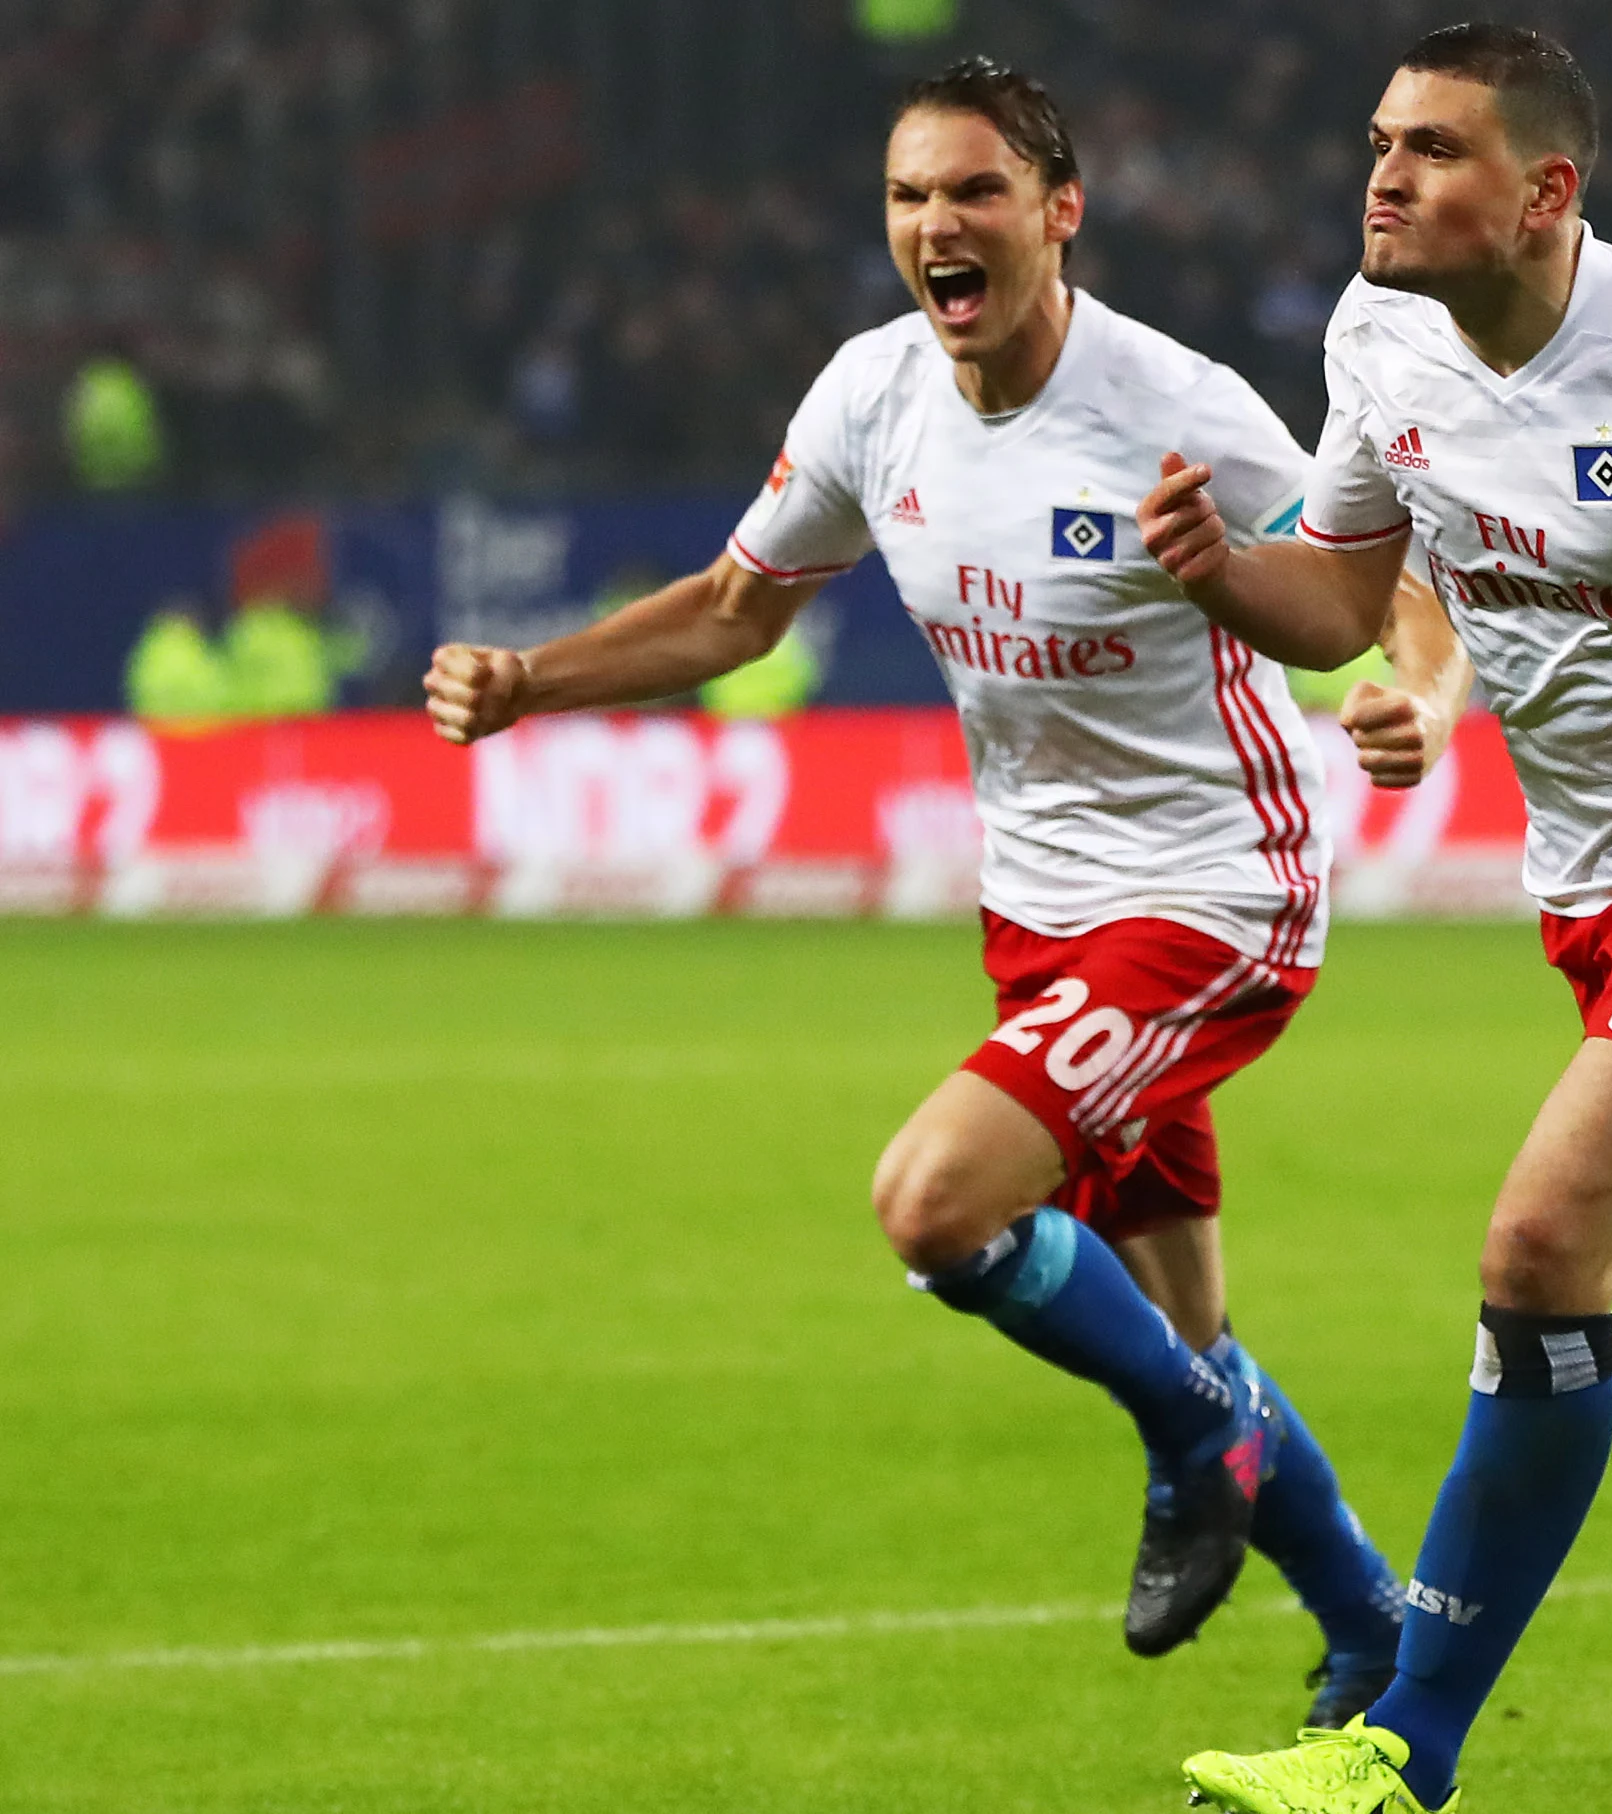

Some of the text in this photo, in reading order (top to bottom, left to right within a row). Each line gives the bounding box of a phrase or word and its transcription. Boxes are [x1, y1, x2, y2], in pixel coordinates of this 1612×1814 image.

[1384, 449, 1430, 471] adidas
[1474, 511, 1548, 569] Fly
[957, 565, 1023, 622] Fly
[905, 603, 1136, 681] mirates
[988, 977, 1134, 1091] 20
